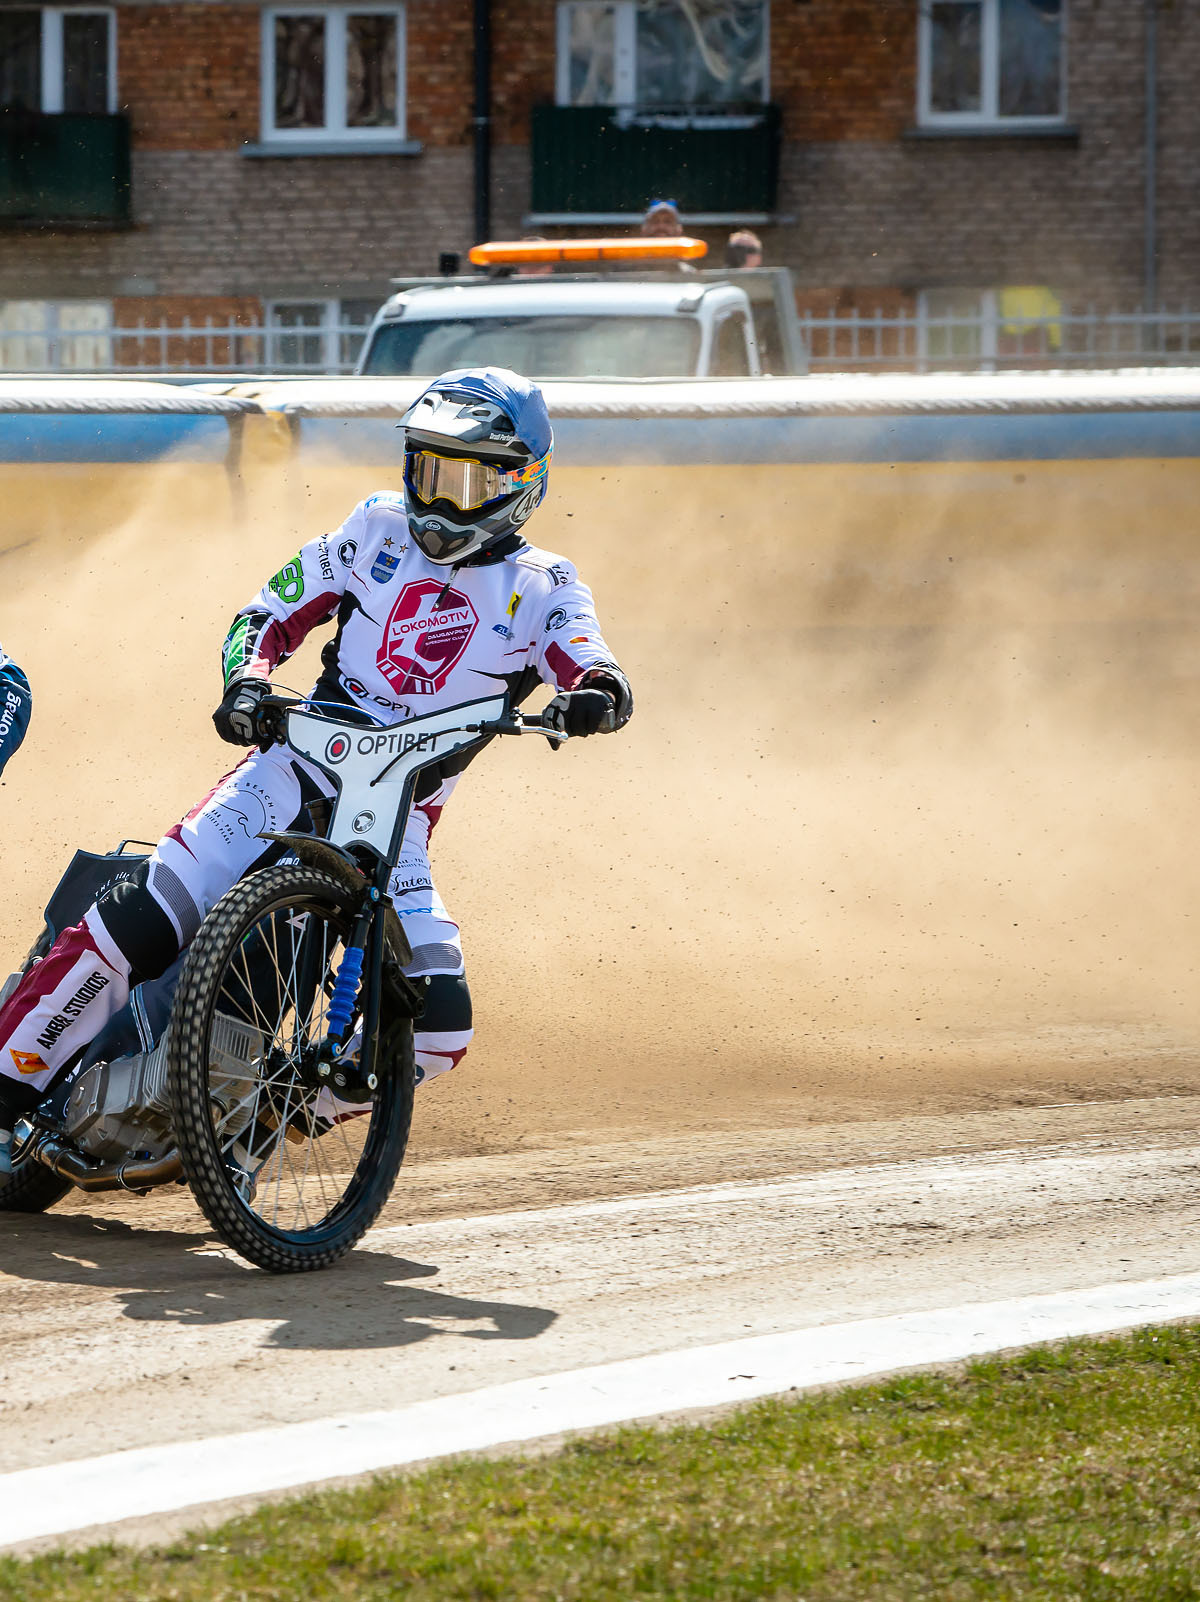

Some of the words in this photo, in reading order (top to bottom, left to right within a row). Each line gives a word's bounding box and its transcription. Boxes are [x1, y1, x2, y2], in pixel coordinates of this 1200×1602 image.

[392, 610, 469, 636] LOKOMOTIV
[357, 732, 438, 755] OPTIBET
[36, 1014, 76, 1050] AMBR
[62, 971, 110, 1017] STUDIOS
